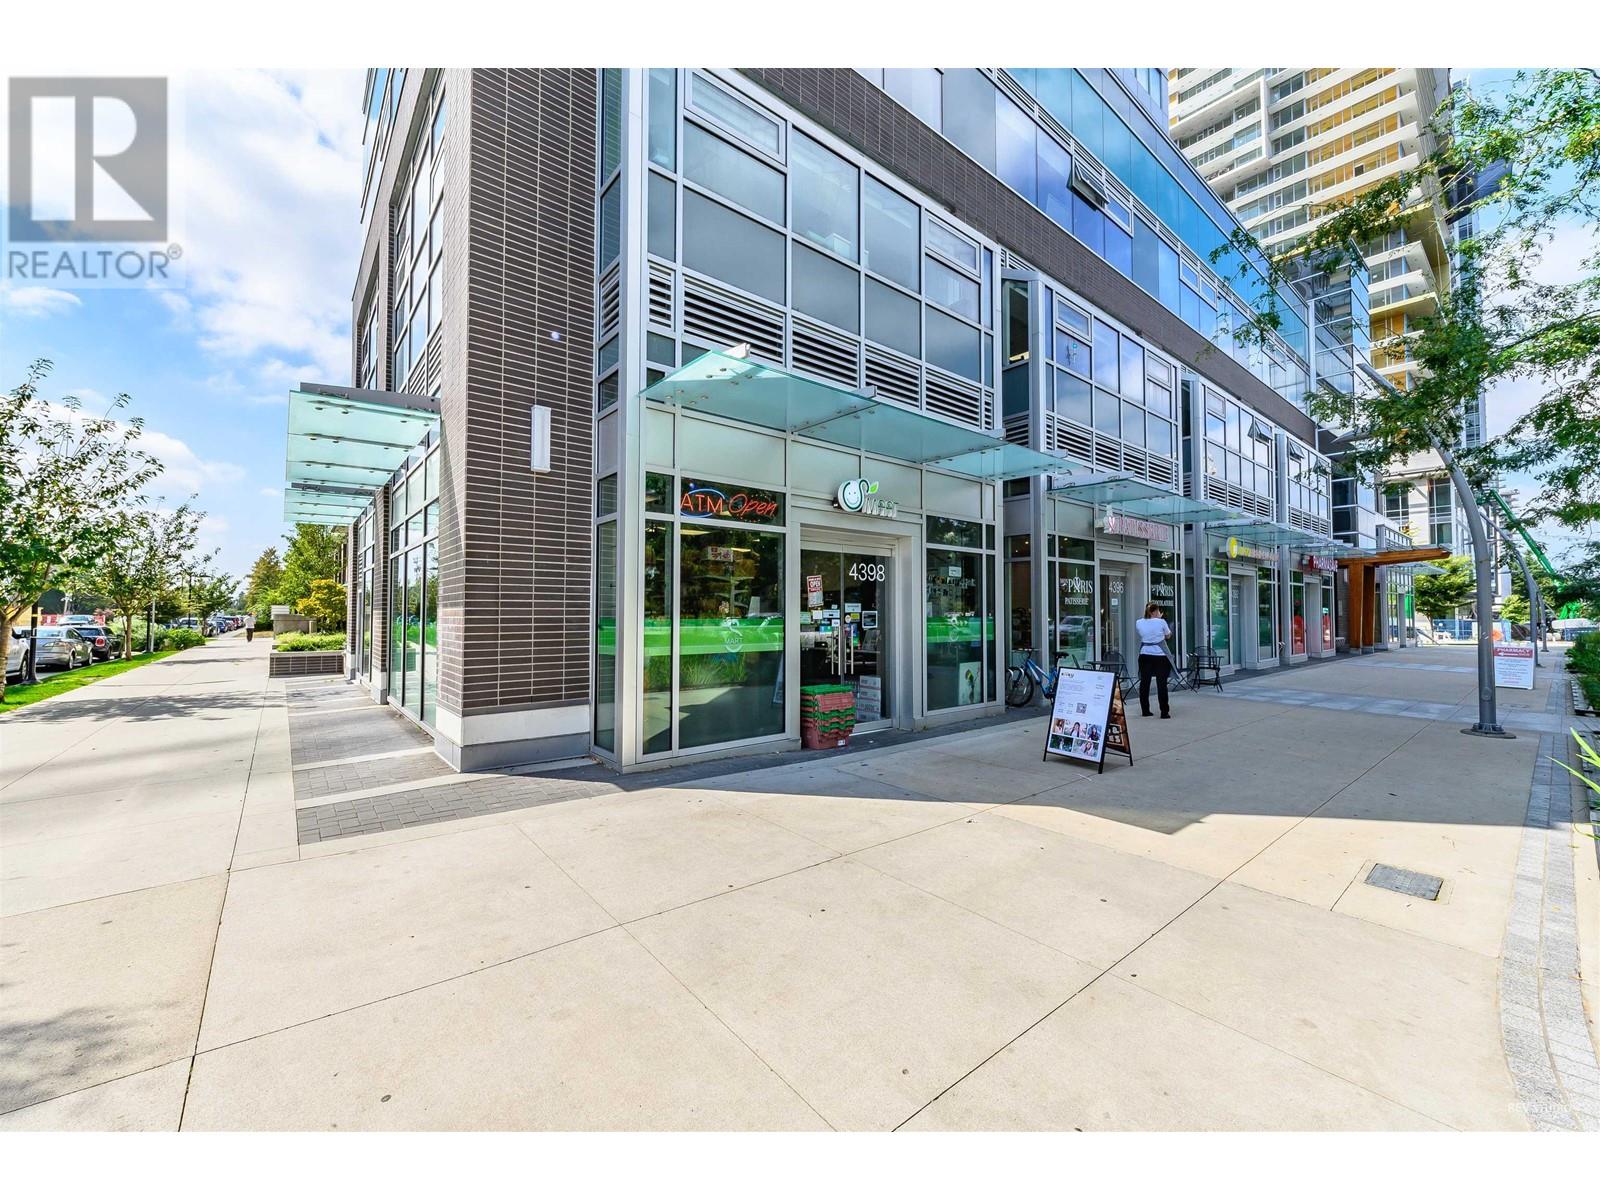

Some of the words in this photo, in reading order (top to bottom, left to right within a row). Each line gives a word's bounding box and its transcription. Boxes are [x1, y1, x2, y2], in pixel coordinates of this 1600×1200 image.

[680, 493, 723, 513] ATM
[728, 493, 778, 517] Open
[848, 562, 886, 582] 4398
[1108, 580, 1124, 594] 4396
